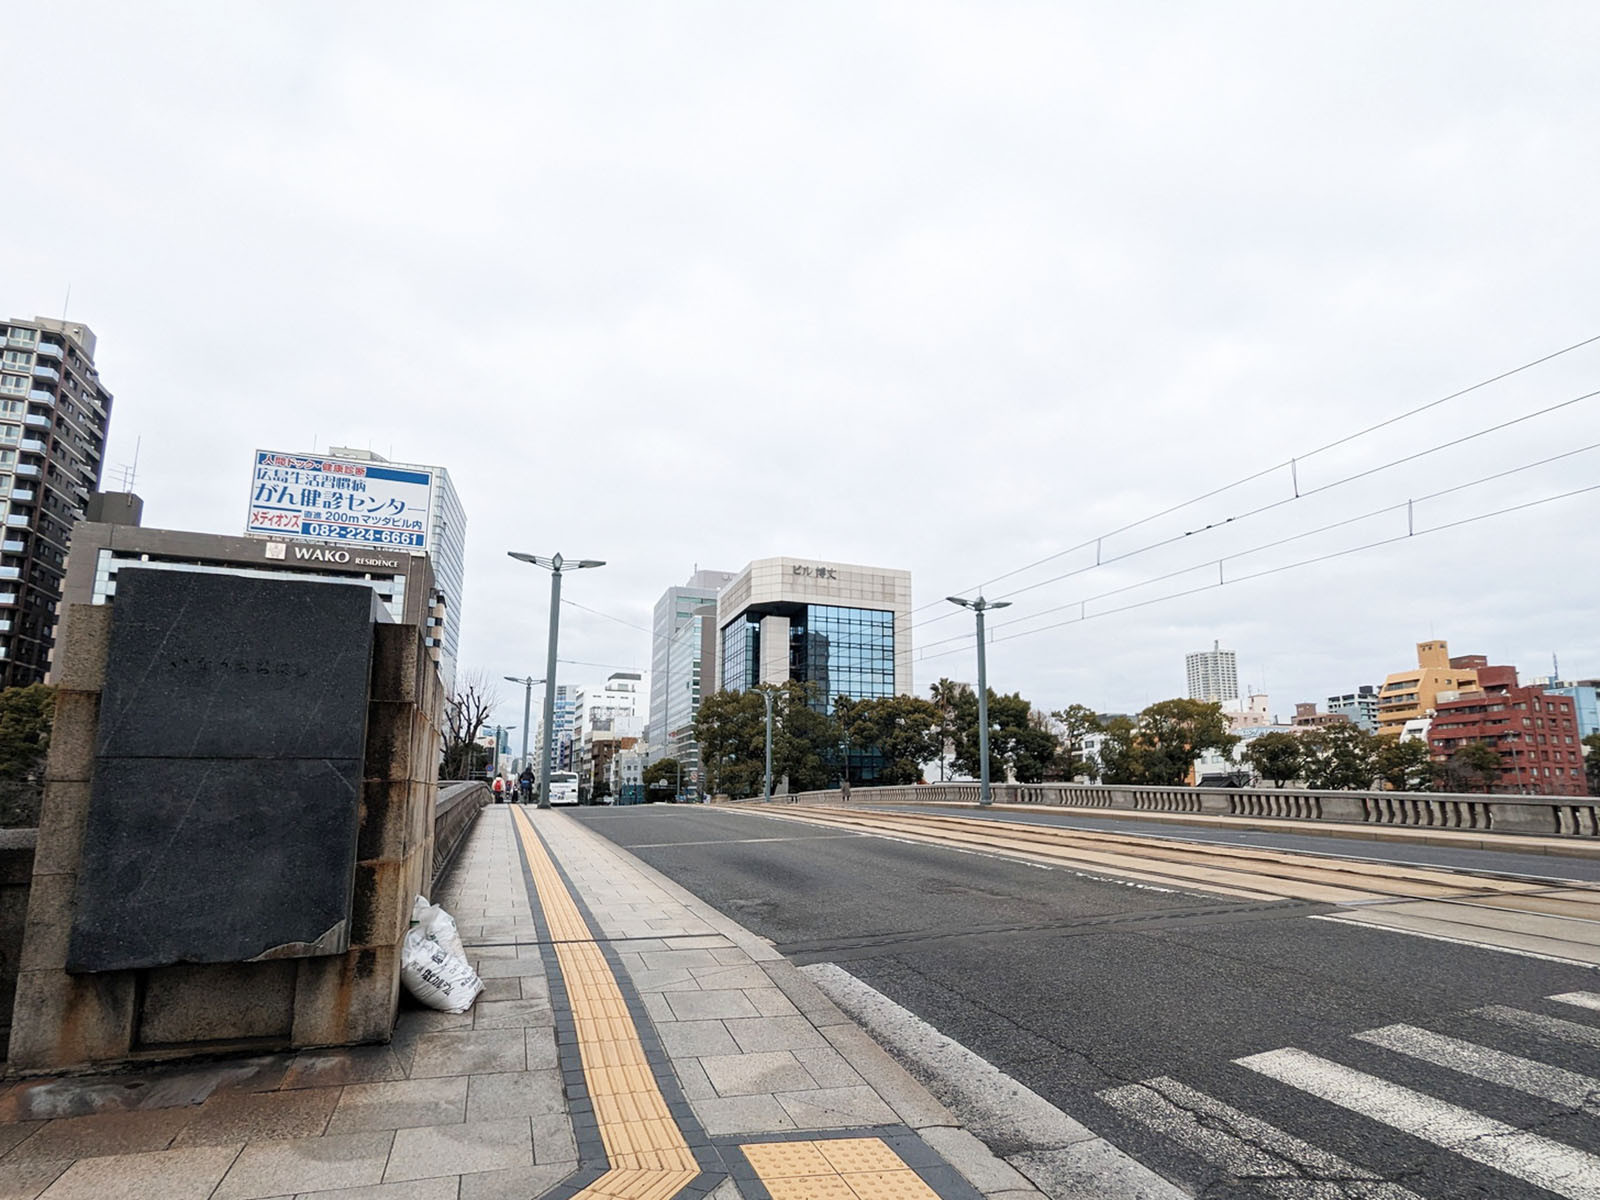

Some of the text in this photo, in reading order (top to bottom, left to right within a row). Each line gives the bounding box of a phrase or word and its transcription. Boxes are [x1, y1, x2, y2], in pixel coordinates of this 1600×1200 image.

[257, 468, 367, 492] 広島生活習慣病
[255, 483, 426, 516] がん健診センター
[310, 524, 417, 545] 082-224-6661
[295, 547, 399, 568] WAKO RESIDENCE
[793, 564, 814, 576] ビル
